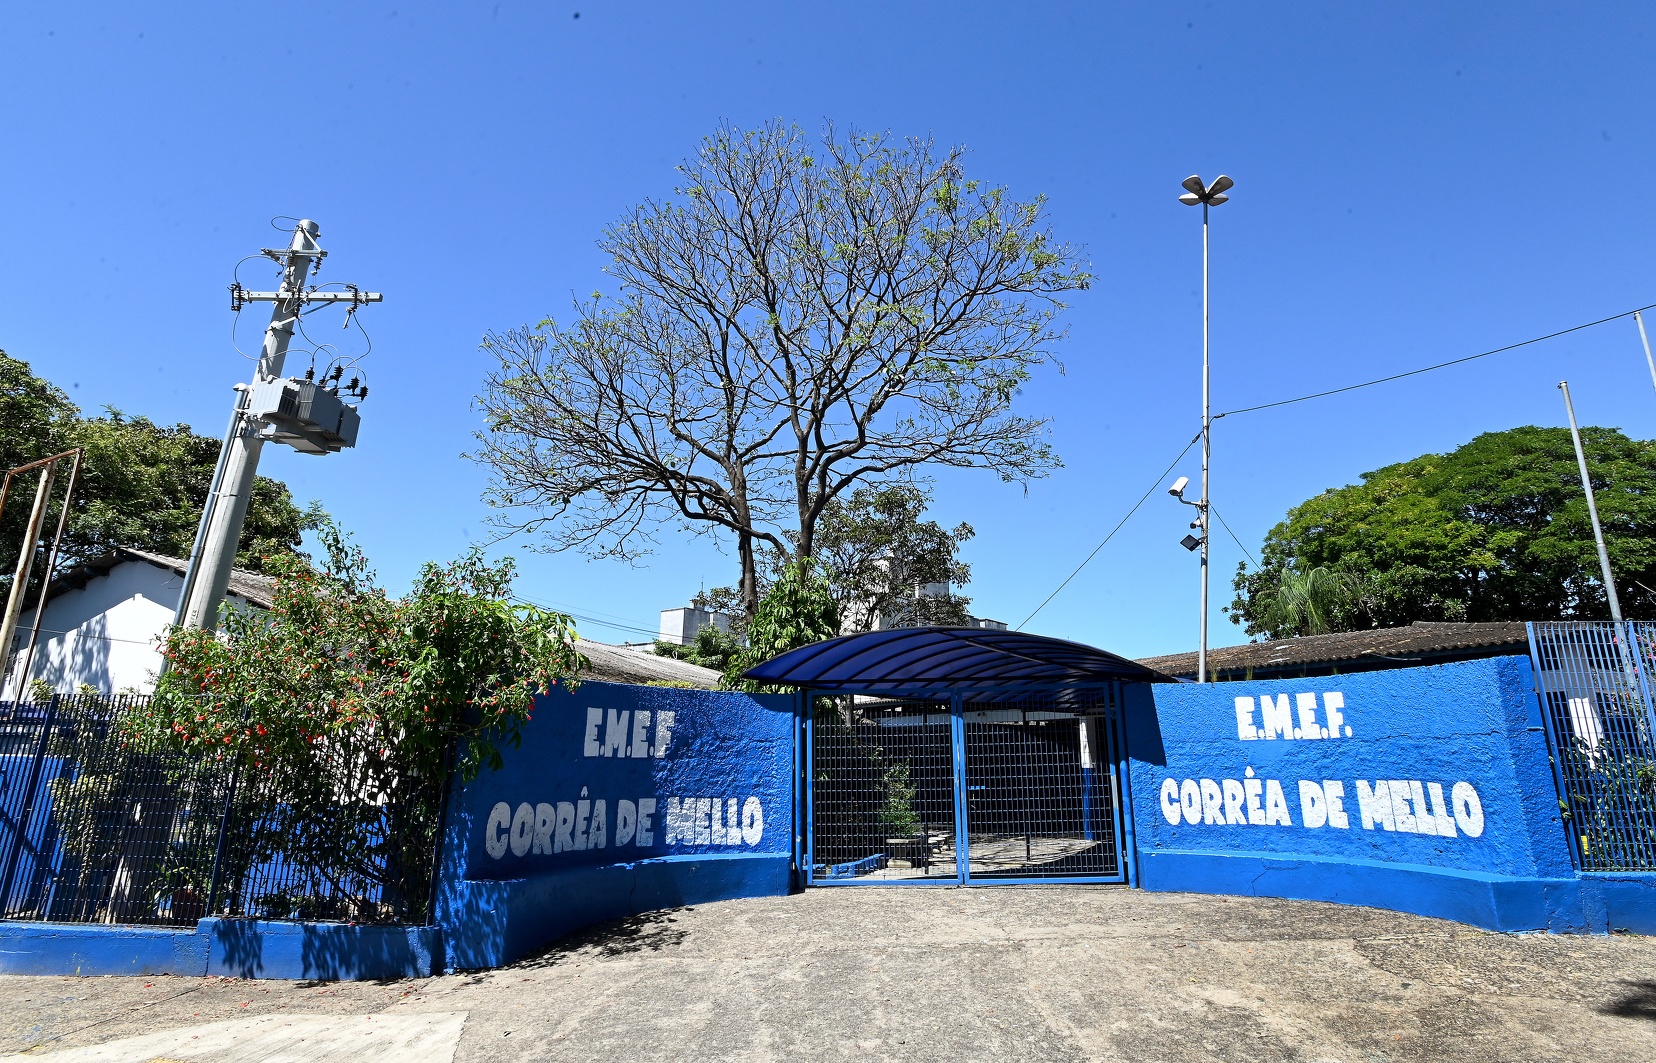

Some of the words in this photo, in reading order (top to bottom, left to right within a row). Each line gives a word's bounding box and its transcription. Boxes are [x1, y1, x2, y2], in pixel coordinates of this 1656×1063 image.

[1234, 691, 1353, 741] E.M.E.F.
[485, 786, 607, 860] CORRÊA
[615, 797, 657, 847] DE
[665, 795, 765, 847] MELLO
[1160, 765, 1293, 826] CORRÊA
[1298, 779, 1350, 829] DE
[1355, 779, 1485, 838] MELLO
